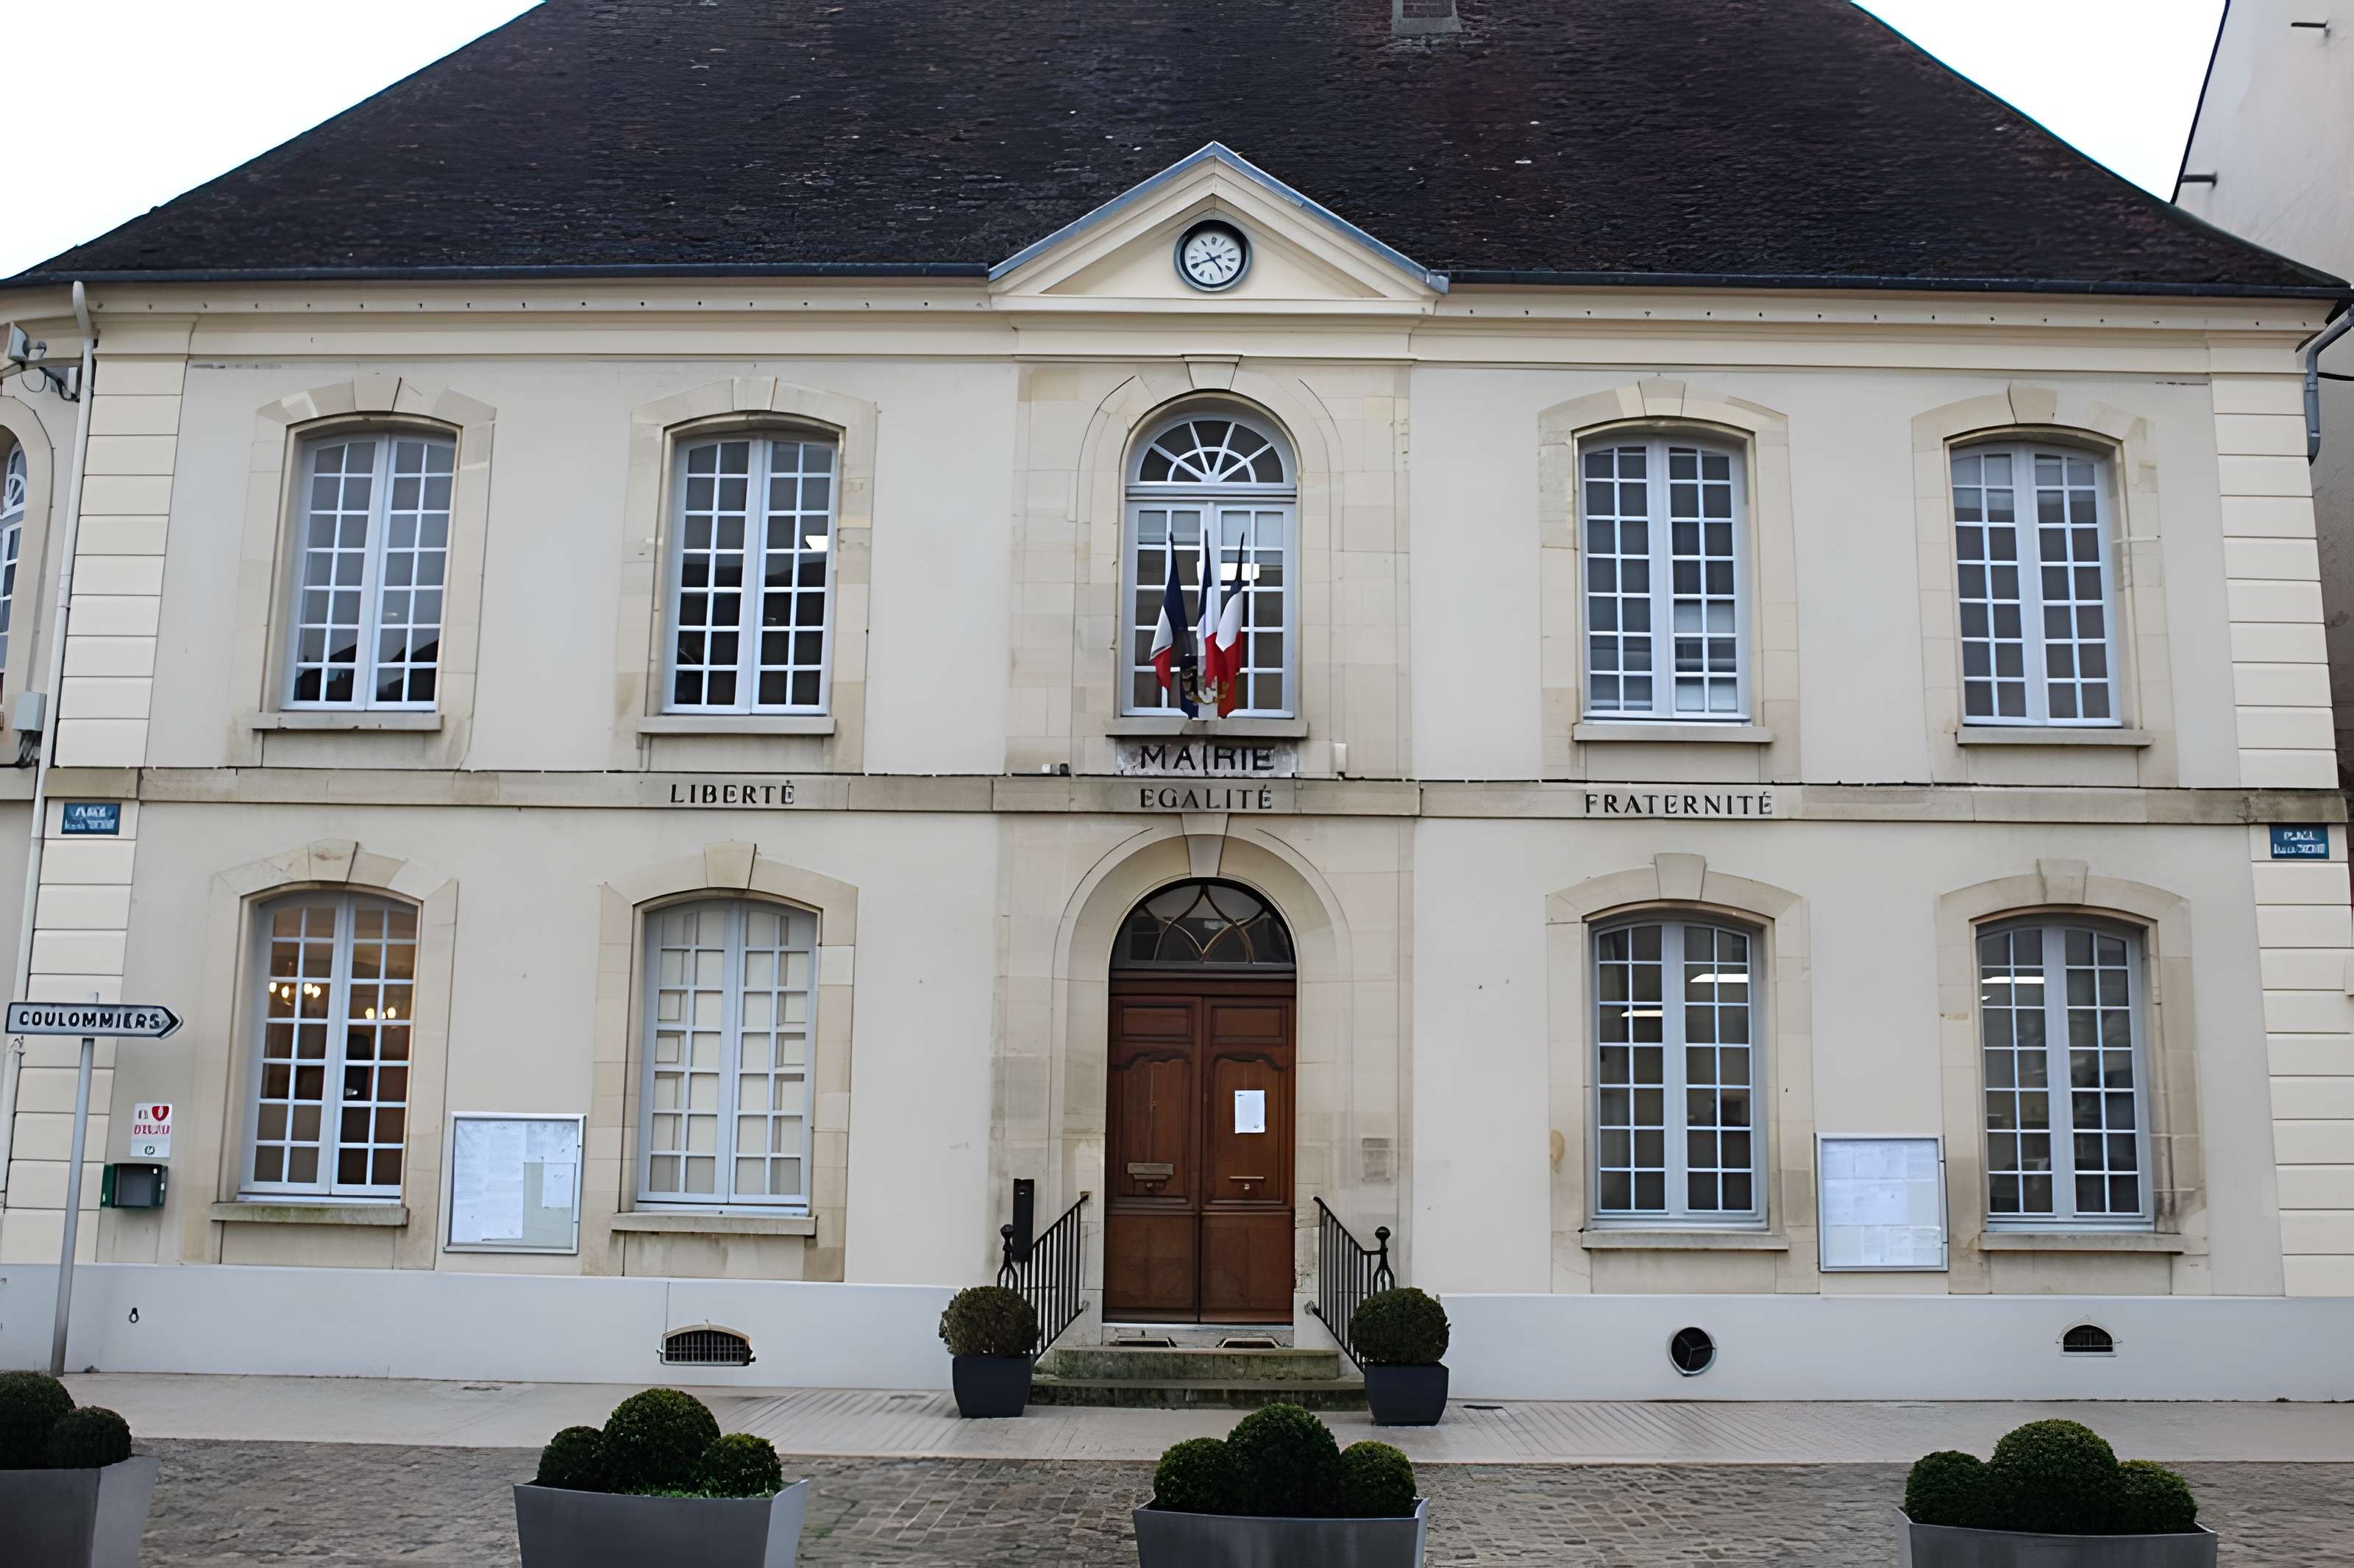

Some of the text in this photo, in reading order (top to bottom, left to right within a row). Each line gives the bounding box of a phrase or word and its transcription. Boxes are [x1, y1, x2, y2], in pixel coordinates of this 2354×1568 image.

[1140, 744, 1274, 771] MAIRIE
[670, 780, 794, 805] LIBERTÉ
[1585, 791, 1772, 815] FRATERNITÉ
[19, 1011, 160, 1030] COULOMMIERS
